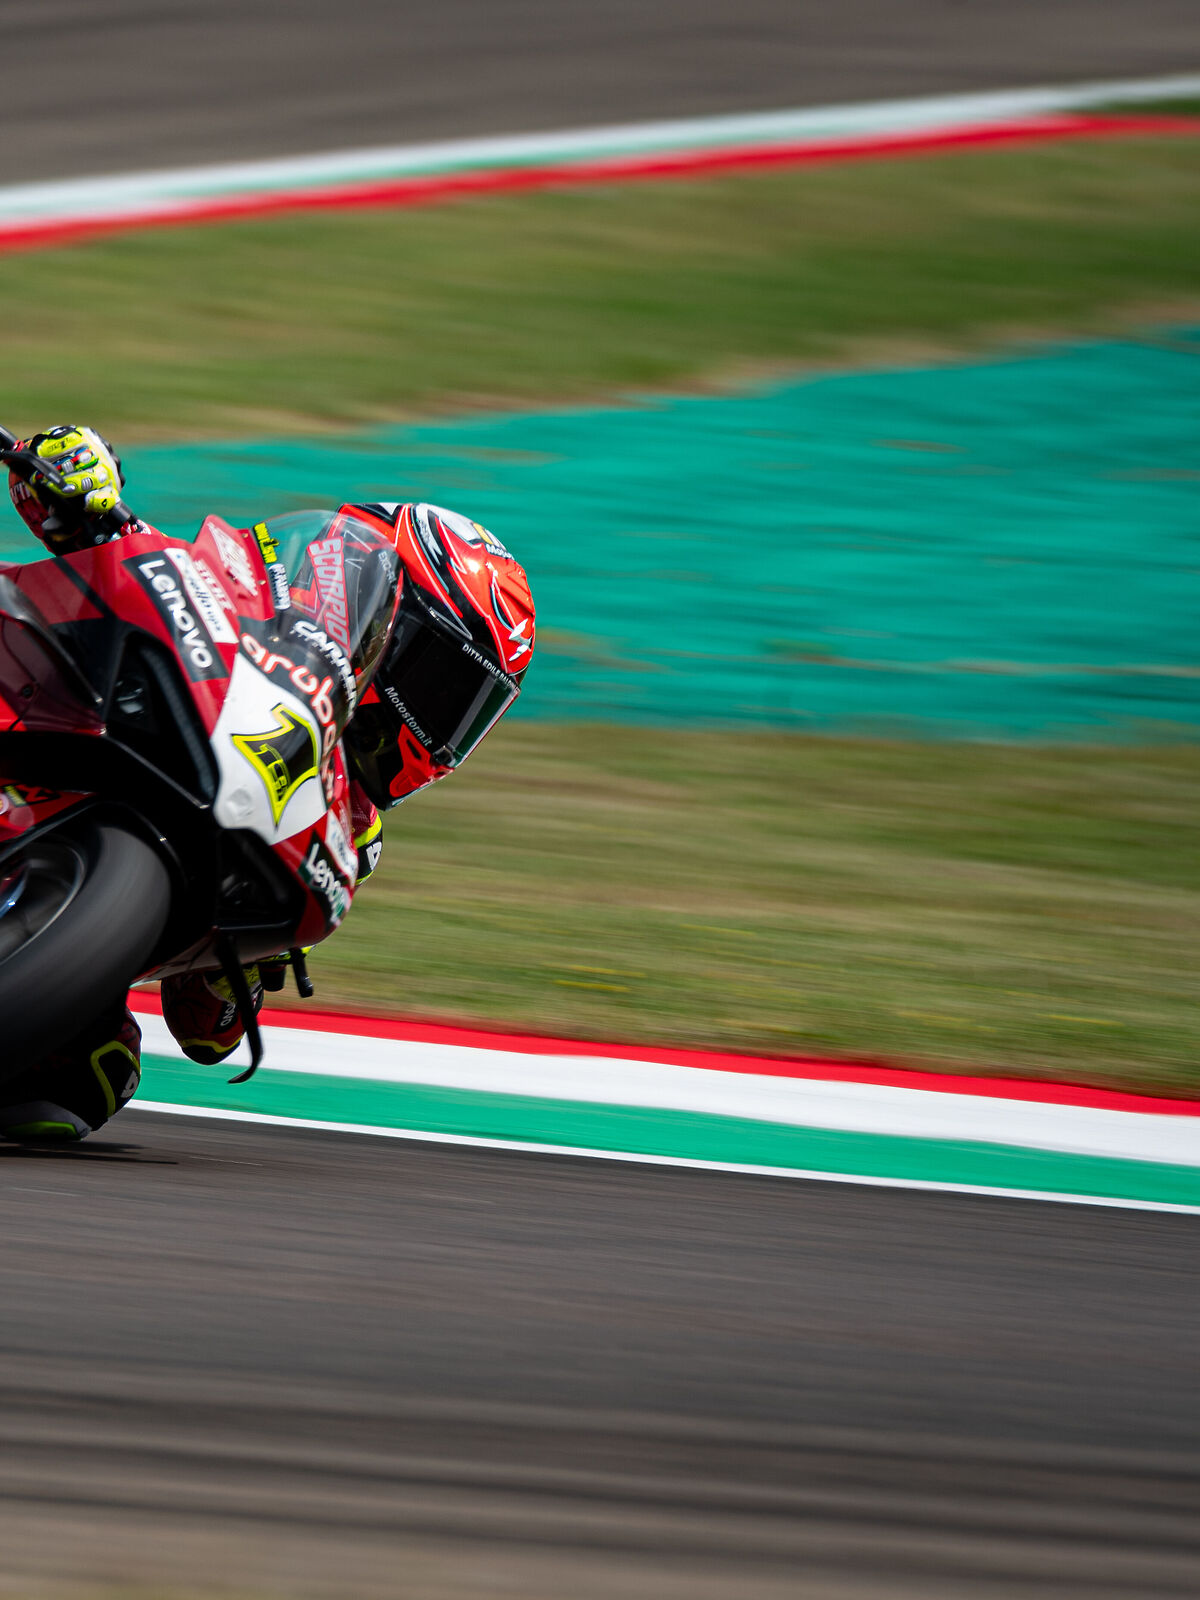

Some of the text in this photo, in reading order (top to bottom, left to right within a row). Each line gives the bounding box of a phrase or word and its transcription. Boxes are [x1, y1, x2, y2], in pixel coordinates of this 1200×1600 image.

[138, 560, 213, 668] Lenovo
[307, 536, 351, 652] SCORPIO
[462, 644, 483, 663] DITTA
[483, 659, 501, 676] EDILE
[385, 686, 433, 747] Motostorm.it
